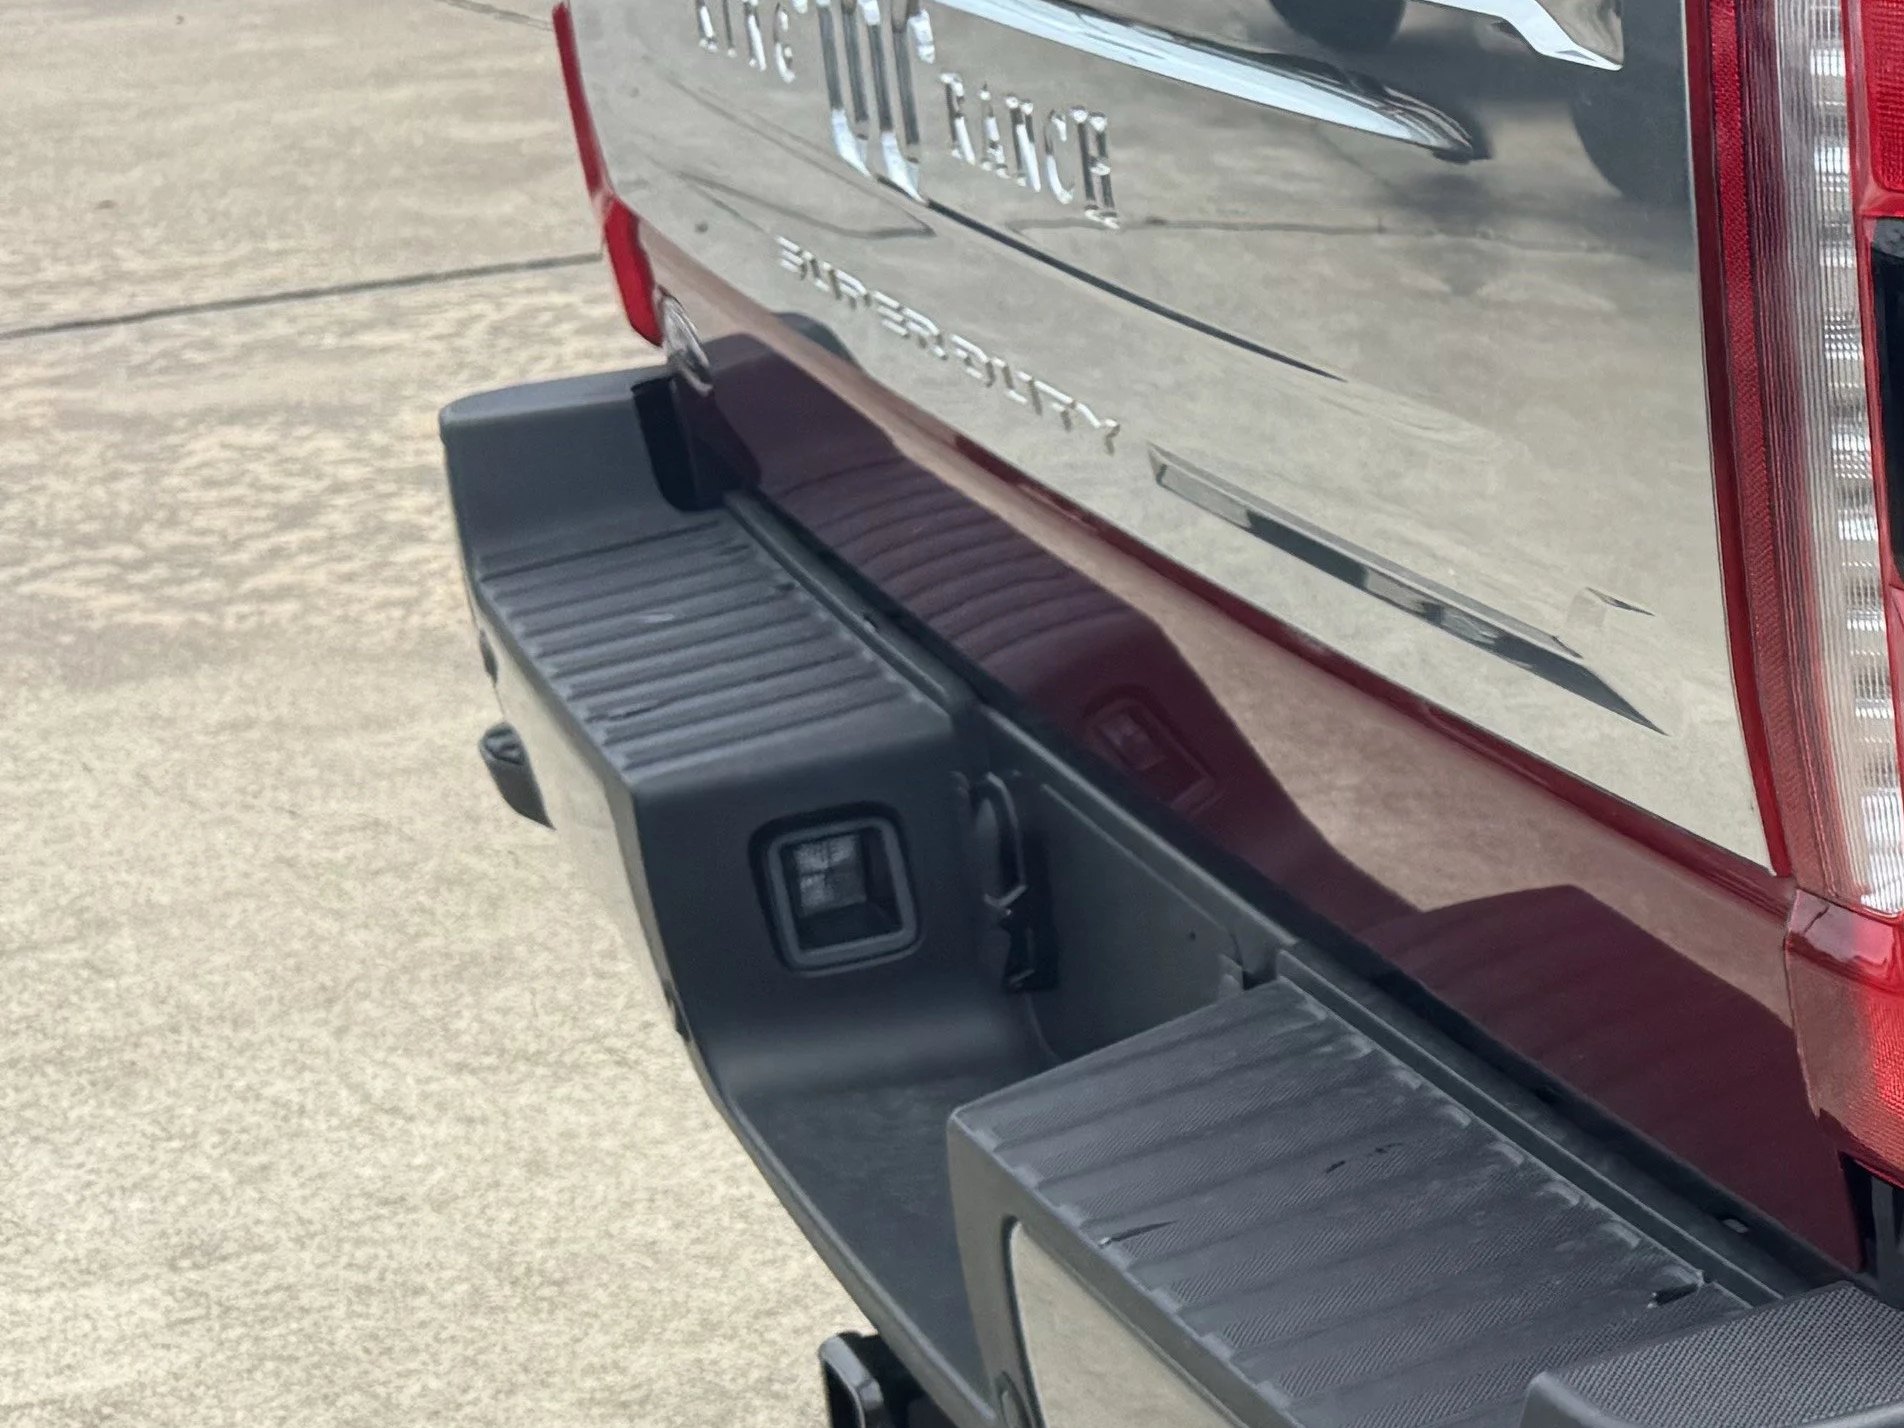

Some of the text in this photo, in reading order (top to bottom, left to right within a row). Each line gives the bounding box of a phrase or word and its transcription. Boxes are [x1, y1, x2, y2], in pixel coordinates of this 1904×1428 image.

[940, 71, 1121, 230] RANCH
[774, 235, 1122, 455] SUPER DUTY
